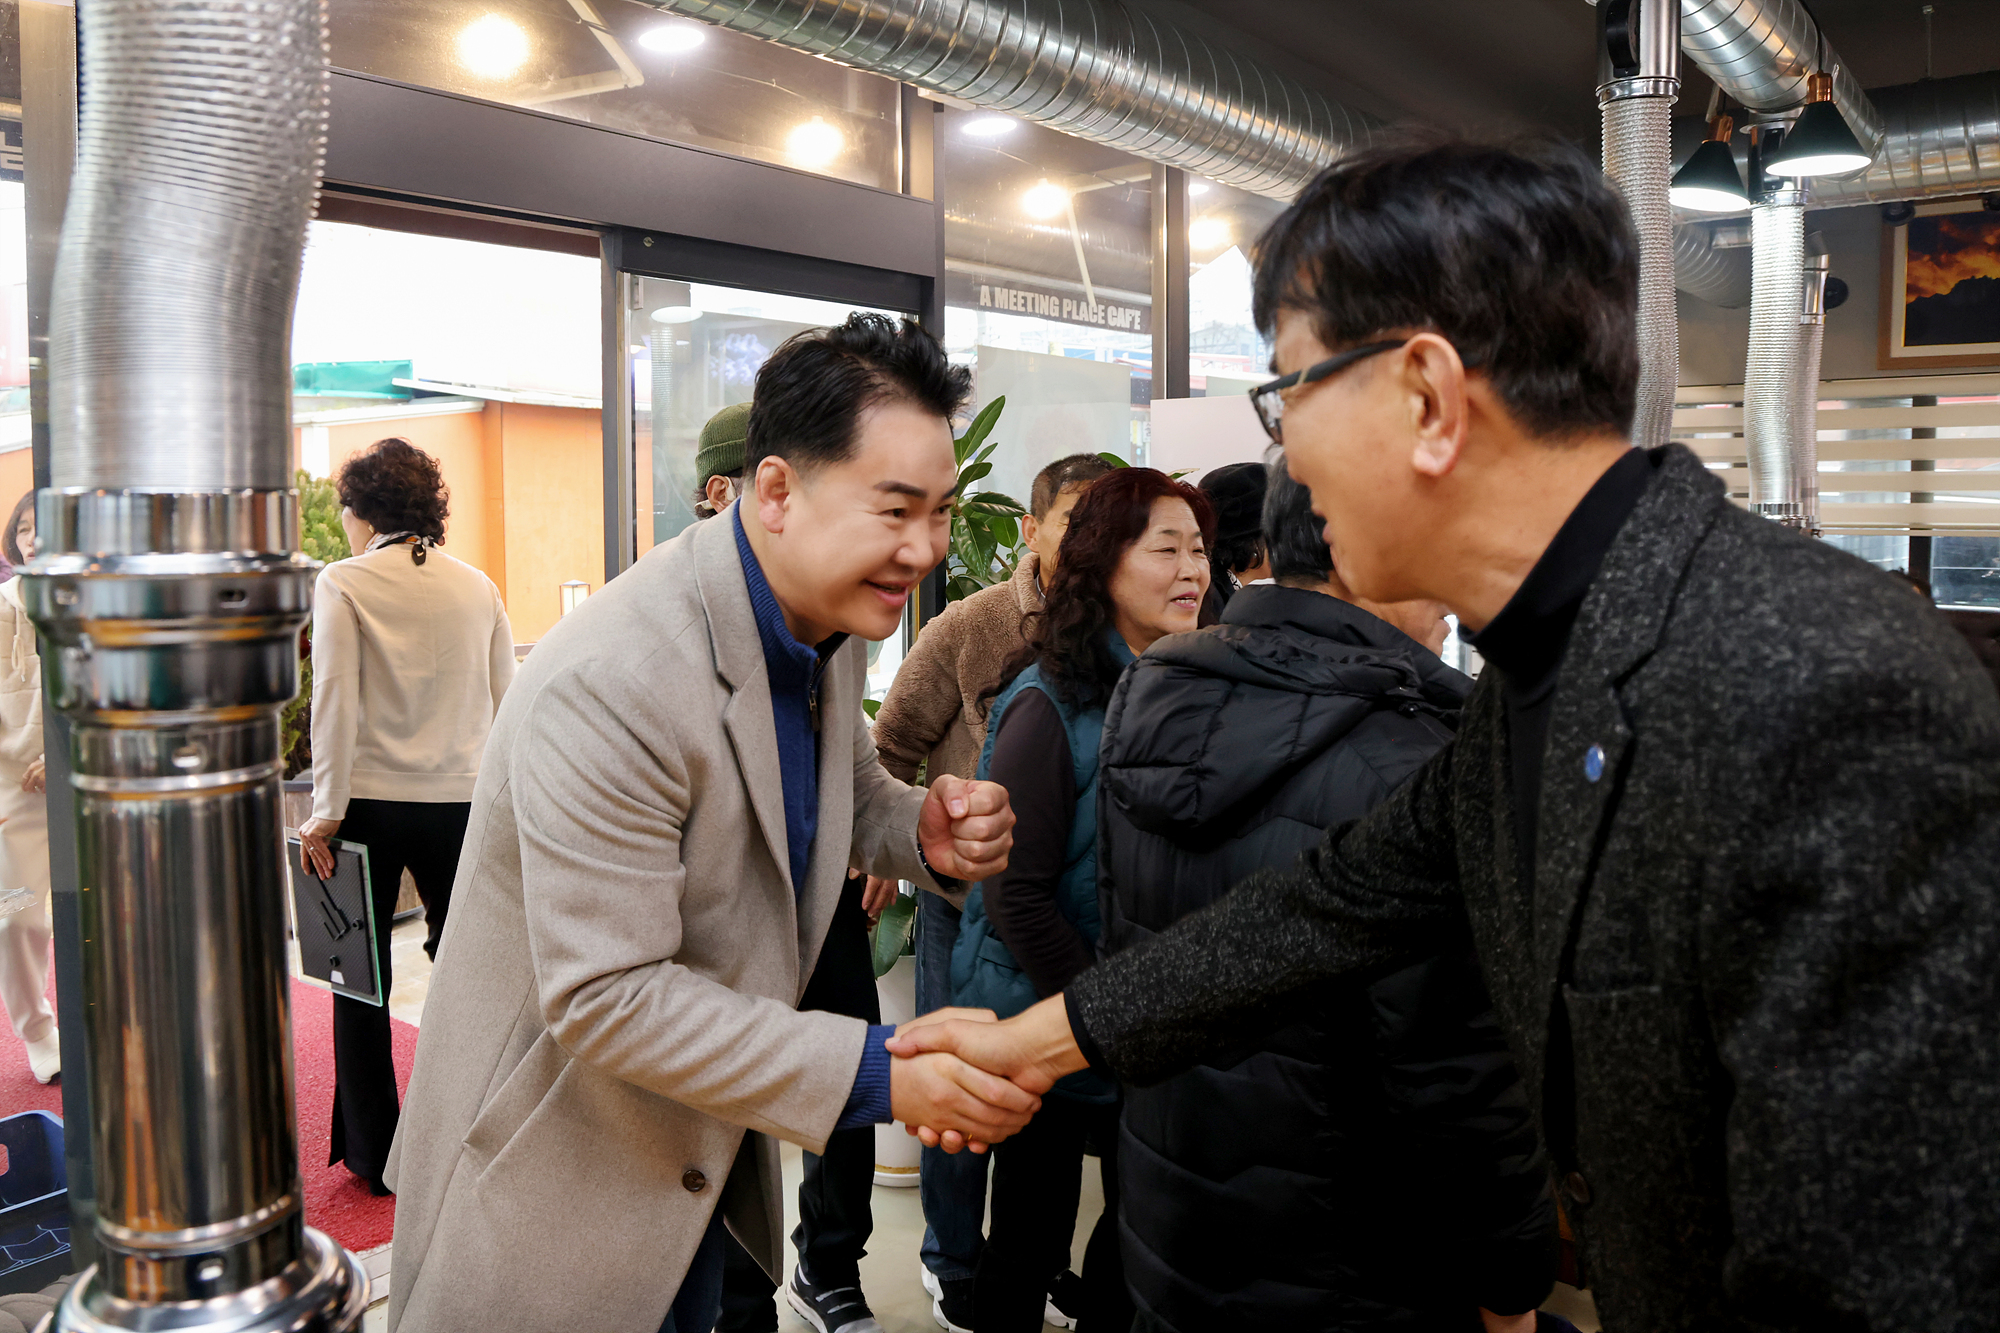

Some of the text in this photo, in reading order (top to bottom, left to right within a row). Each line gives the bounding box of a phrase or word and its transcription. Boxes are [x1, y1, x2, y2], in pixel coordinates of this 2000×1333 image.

[980, 285, 991, 307] A
[995, 288, 1060, 317] MEETING
[1063, 299, 1105, 325] PLACE
